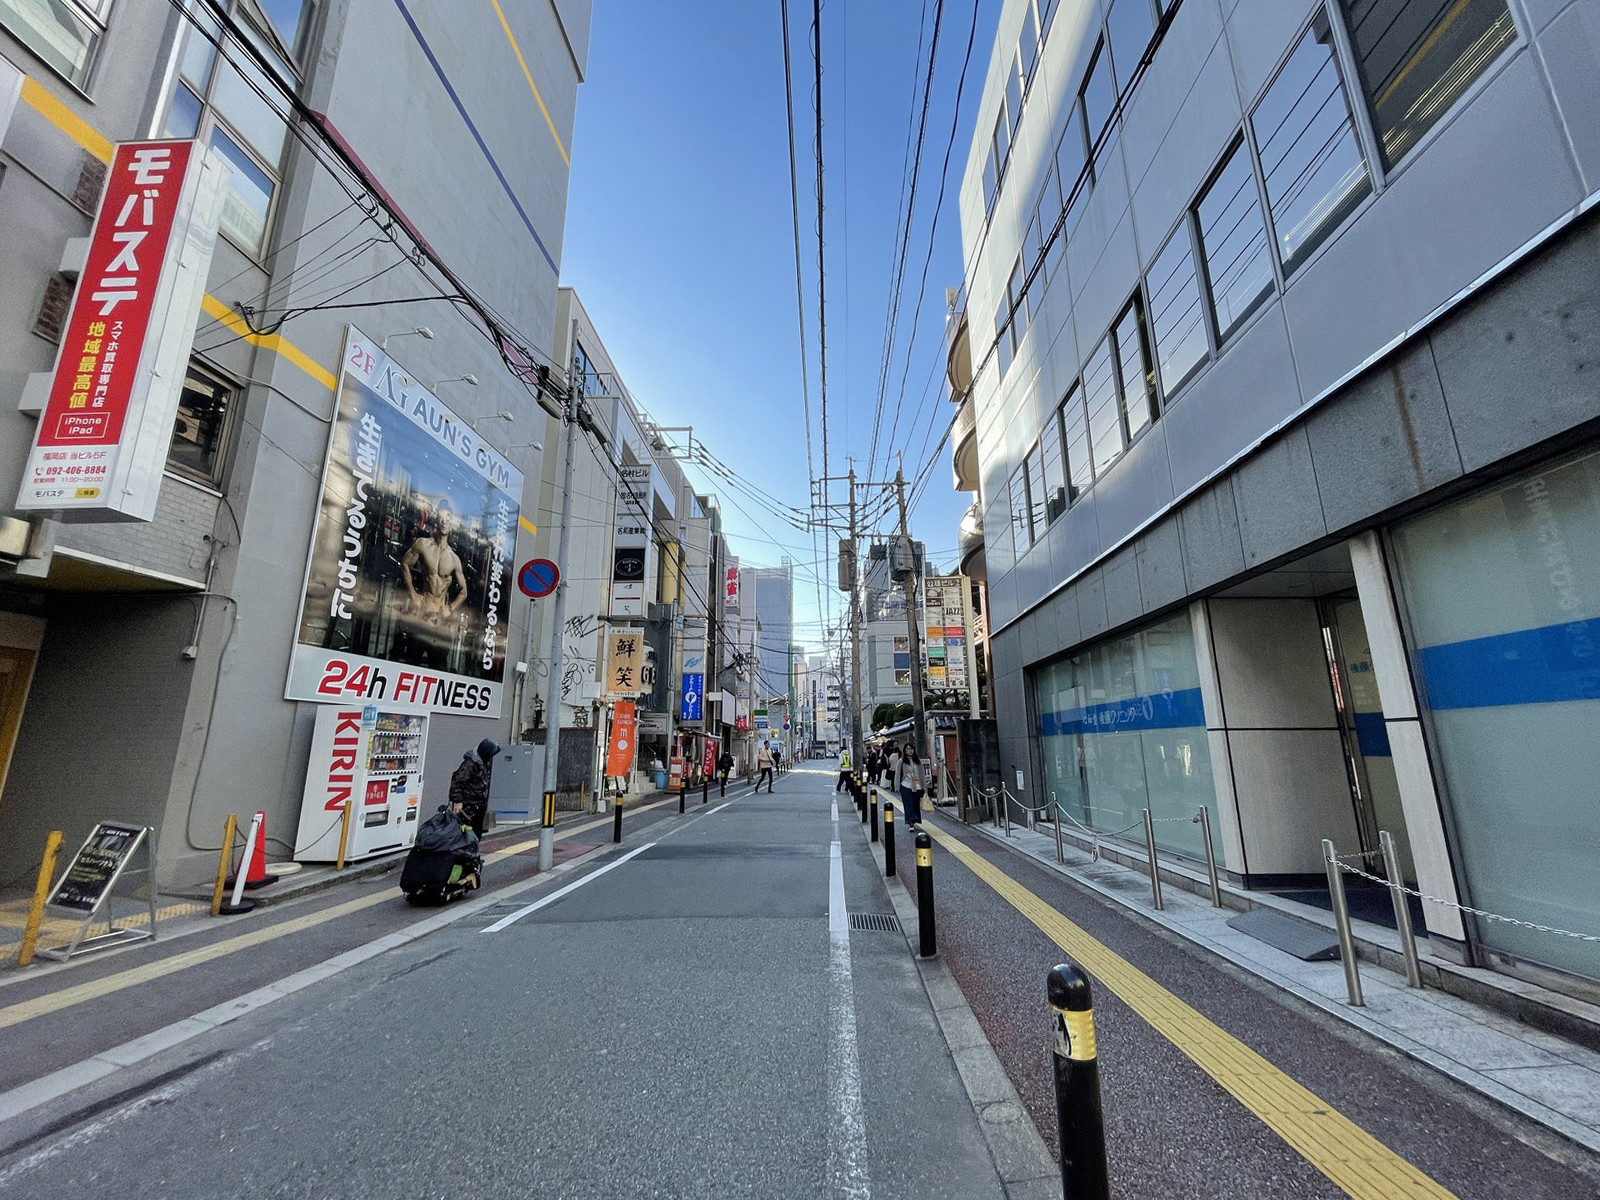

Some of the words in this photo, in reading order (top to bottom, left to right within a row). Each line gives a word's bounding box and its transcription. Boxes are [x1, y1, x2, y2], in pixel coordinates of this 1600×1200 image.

[92, 149, 171, 316] モバステ
[69, 321, 106, 408] 地域最高値
[92, 321, 123, 407] スマホ買取専門店
[64, 417, 102, 425] iPhone
[68, 426, 93, 435] iPad
[350, 342, 378, 376] 2F
[412, 398, 474, 459] AUN'S
[475, 446, 512, 490] GYM
[34, 489, 65, 498] モバステ
[330, 411, 381, 620] 生きてるうちに
[483, 498, 510, 671] 生まれ変わるなら
[726, 566, 738, 596] 麻雀
[316, 659, 388, 699] 24h
[392, 670, 493, 712] FITNESS
[615, 638, 636, 688] 鮮笑
[324, 711, 363, 811] KIRIN
